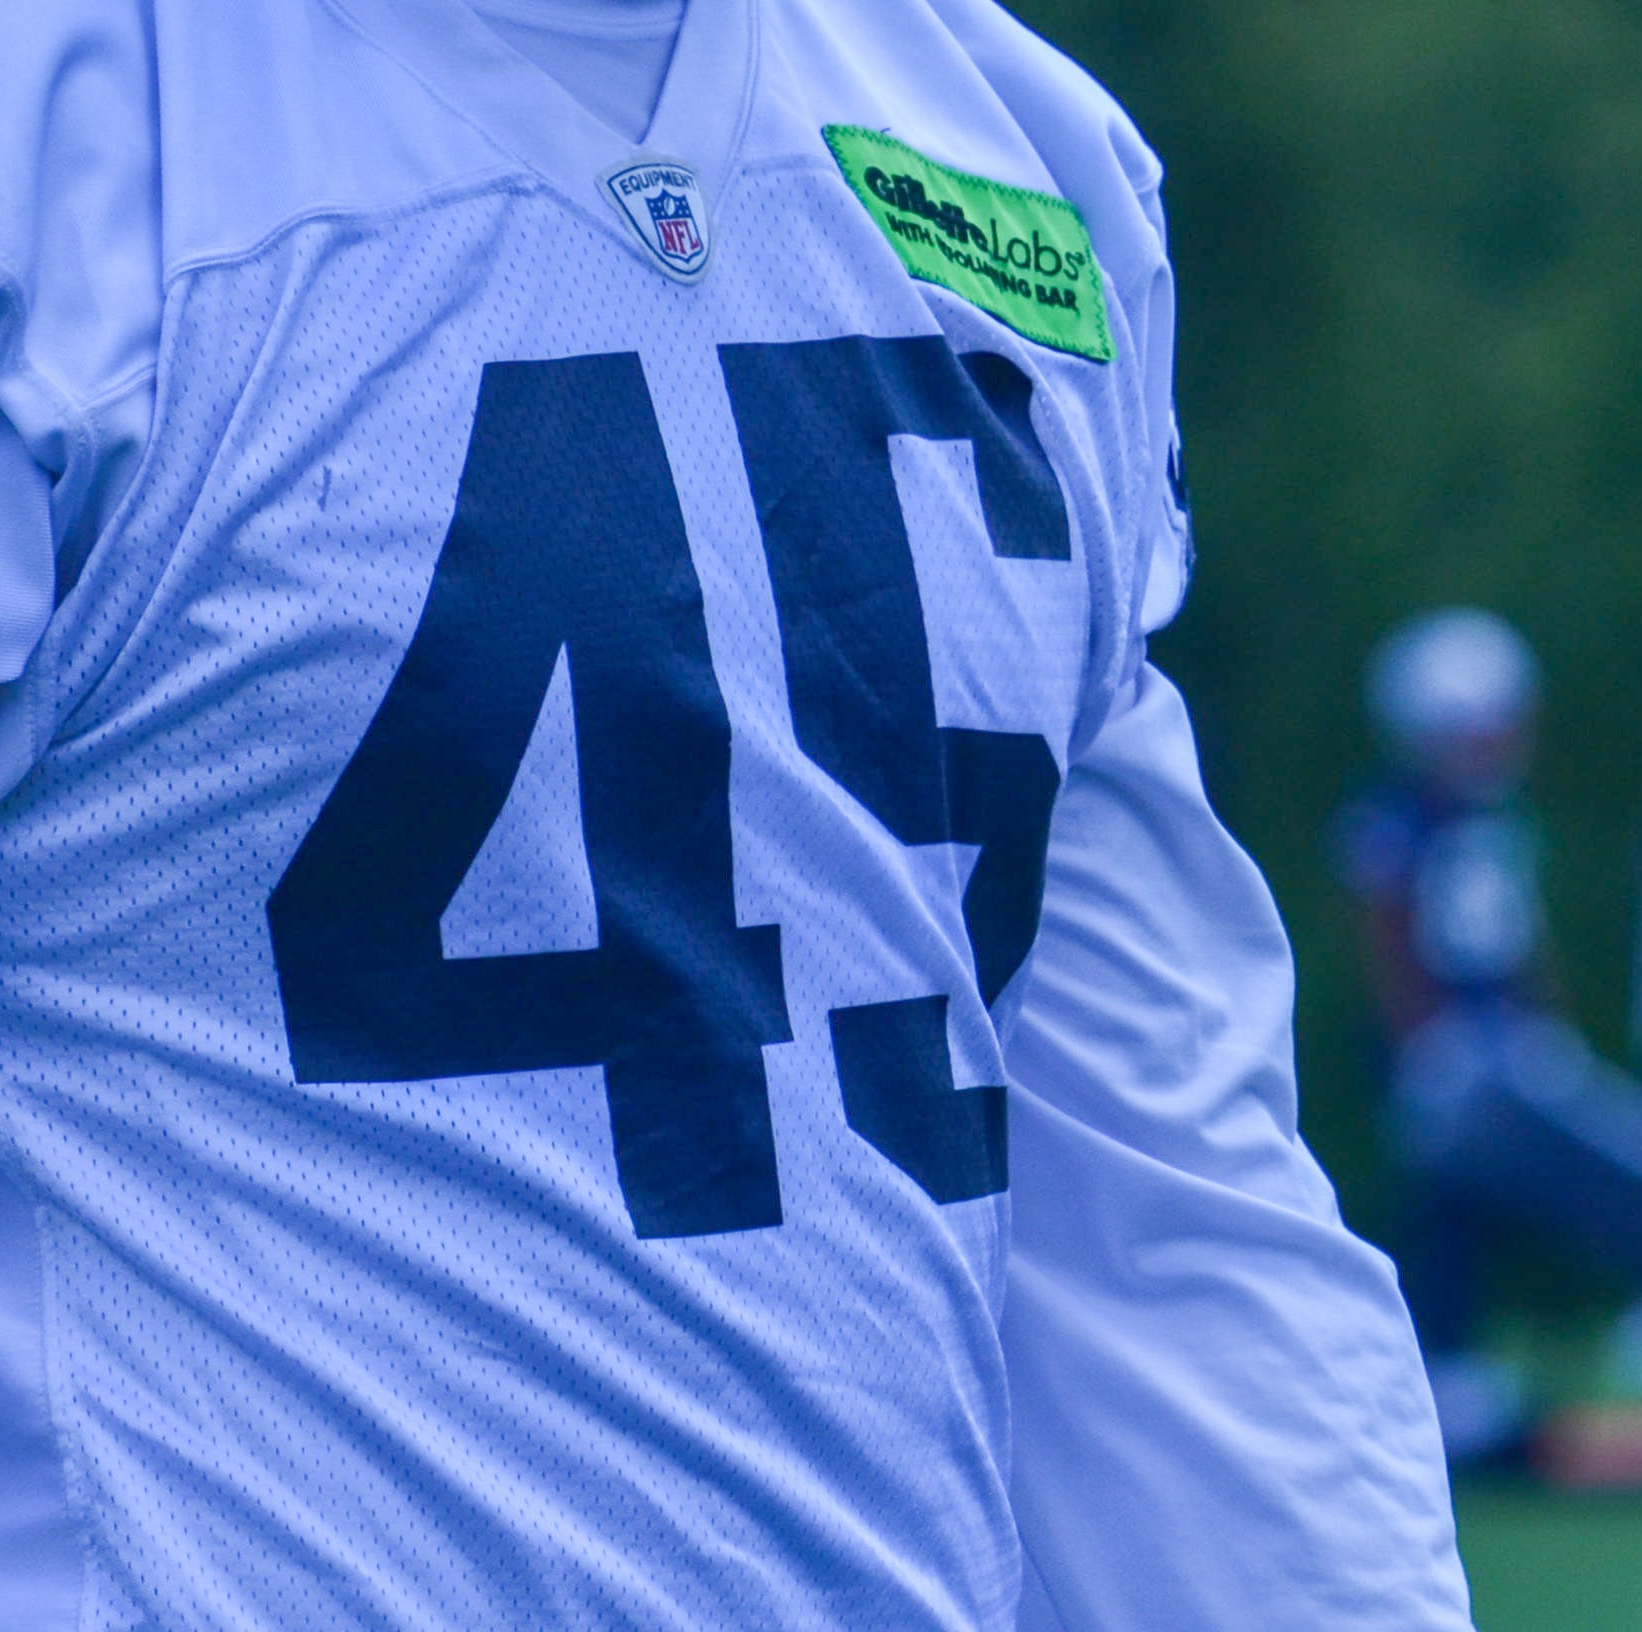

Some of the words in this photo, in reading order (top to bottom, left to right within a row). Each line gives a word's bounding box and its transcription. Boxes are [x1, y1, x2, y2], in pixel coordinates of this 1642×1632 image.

[618, 170, 698, 196] EQUIPMENT
[658, 219, 701, 255] NFL
[1035, 283, 1079, 312] BAR
[265, 334, 1072, 1240] 45
